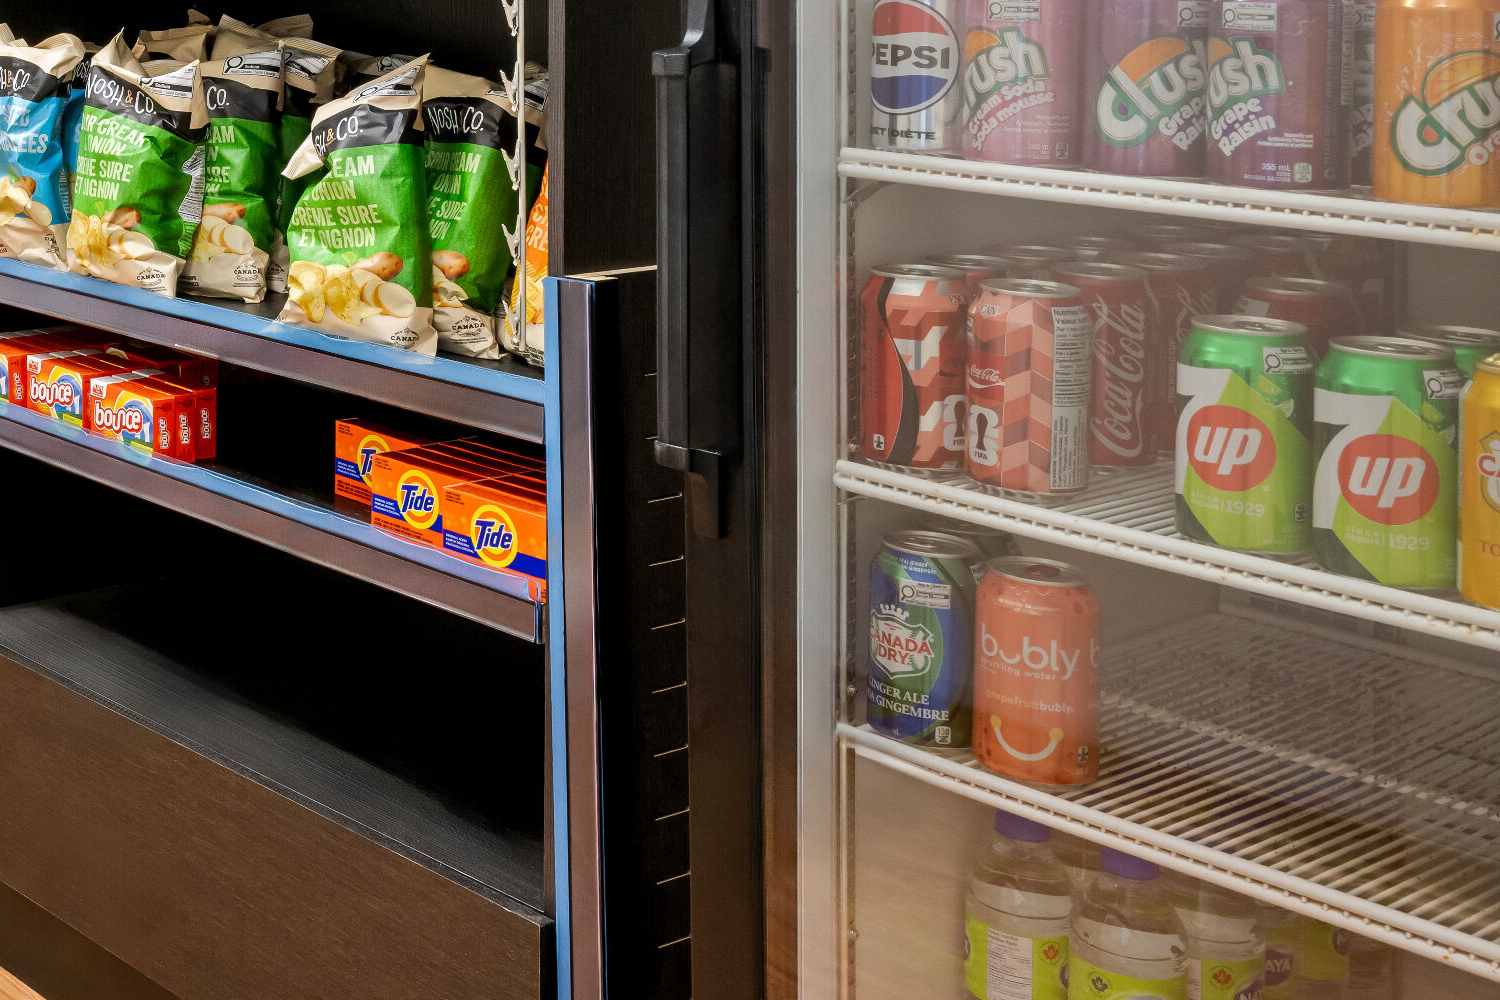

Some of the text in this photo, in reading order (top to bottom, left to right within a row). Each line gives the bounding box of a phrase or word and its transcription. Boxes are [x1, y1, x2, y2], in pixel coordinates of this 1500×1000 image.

[963, 31, 1046, 108] rush
[1209, 37, 1280, 109] ush
[125, 90, 134, 105] &
[134, 90, 157, 115] CO.
[206, 86, 230, 110] CO.
[336, 115, 364, 142] CO.
[427, 106, 485, 136] NOSH CO.
[1211, 98, 1262, 140] Grape
[1218, 114, 1276, 157] Raisin
[99, 159, 134, 183] SURE
[332, 155, 375, 178] EAM
[1261, 162, 1292, 172] 355 mL
[291, 203, 382, 227] CRÈME SURE
[299, 227, 376, 249] ET OIGNON
[136, 274, 165, 283] CANADA
[451, 322, 486, 332] CANADA
[14, 372, 23, 400] bounce
[30, 376, 74, 406] bounce
[95, 401, 142, 433] bounce
[181, 413, 189, 444] bounce
[202, 408, 210, 439] bounce
[160, 418, 170, 449] bounce
[360, 447, 372, 476] Ti
[975, 451, 988, 460] FIFA
[400, 484, 435, 513] Tide
[1226, 502, 1265, 518] 1929
[474, 519, 513, 551] Tide
[1388, 534, 1429, 551] 1929
[909, 560, 928, 568] GINGER
[981, 623, 1080, 681] bubly
[1025, 670, 1057, 680] water
[869, 676, 929, 706] GINGER ALE
[876, 695, 949, 721] GINGEMBRE
[1266, 959, 1291, 973] AYA
